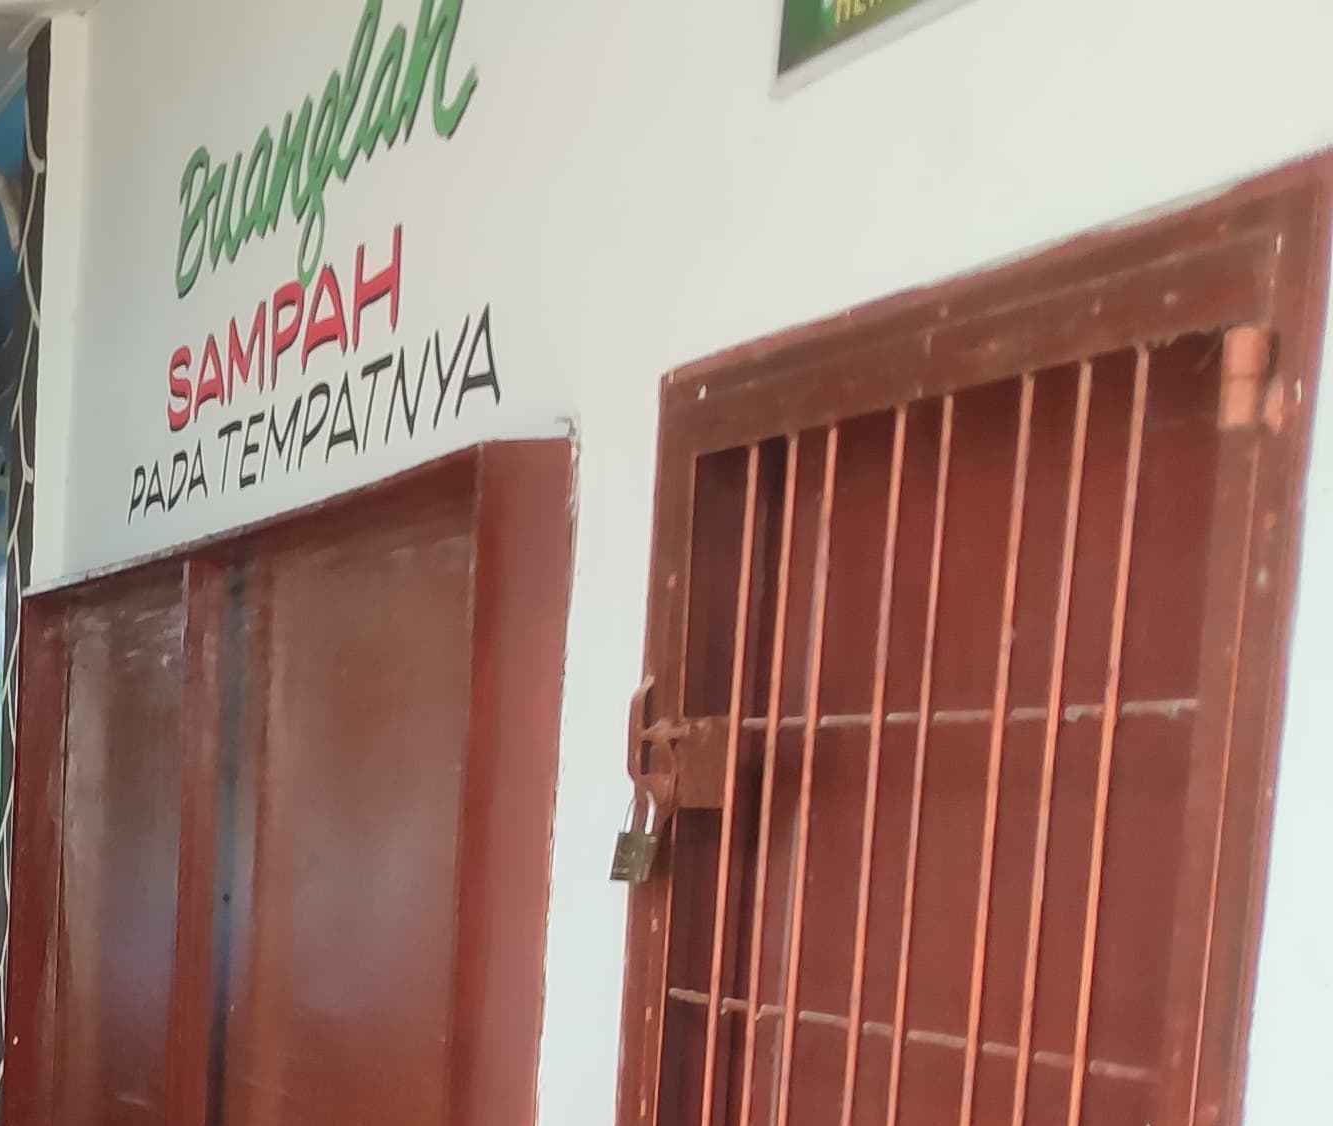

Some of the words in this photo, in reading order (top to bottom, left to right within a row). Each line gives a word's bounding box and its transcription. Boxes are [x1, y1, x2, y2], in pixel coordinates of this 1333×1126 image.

[175, 0, 479, 299] Buanglah
[127, 440, 209, 526] PADA
[217, 302, 502, 494] TEMPATNYA
[167, 222, 402, 433] SAMPAH
